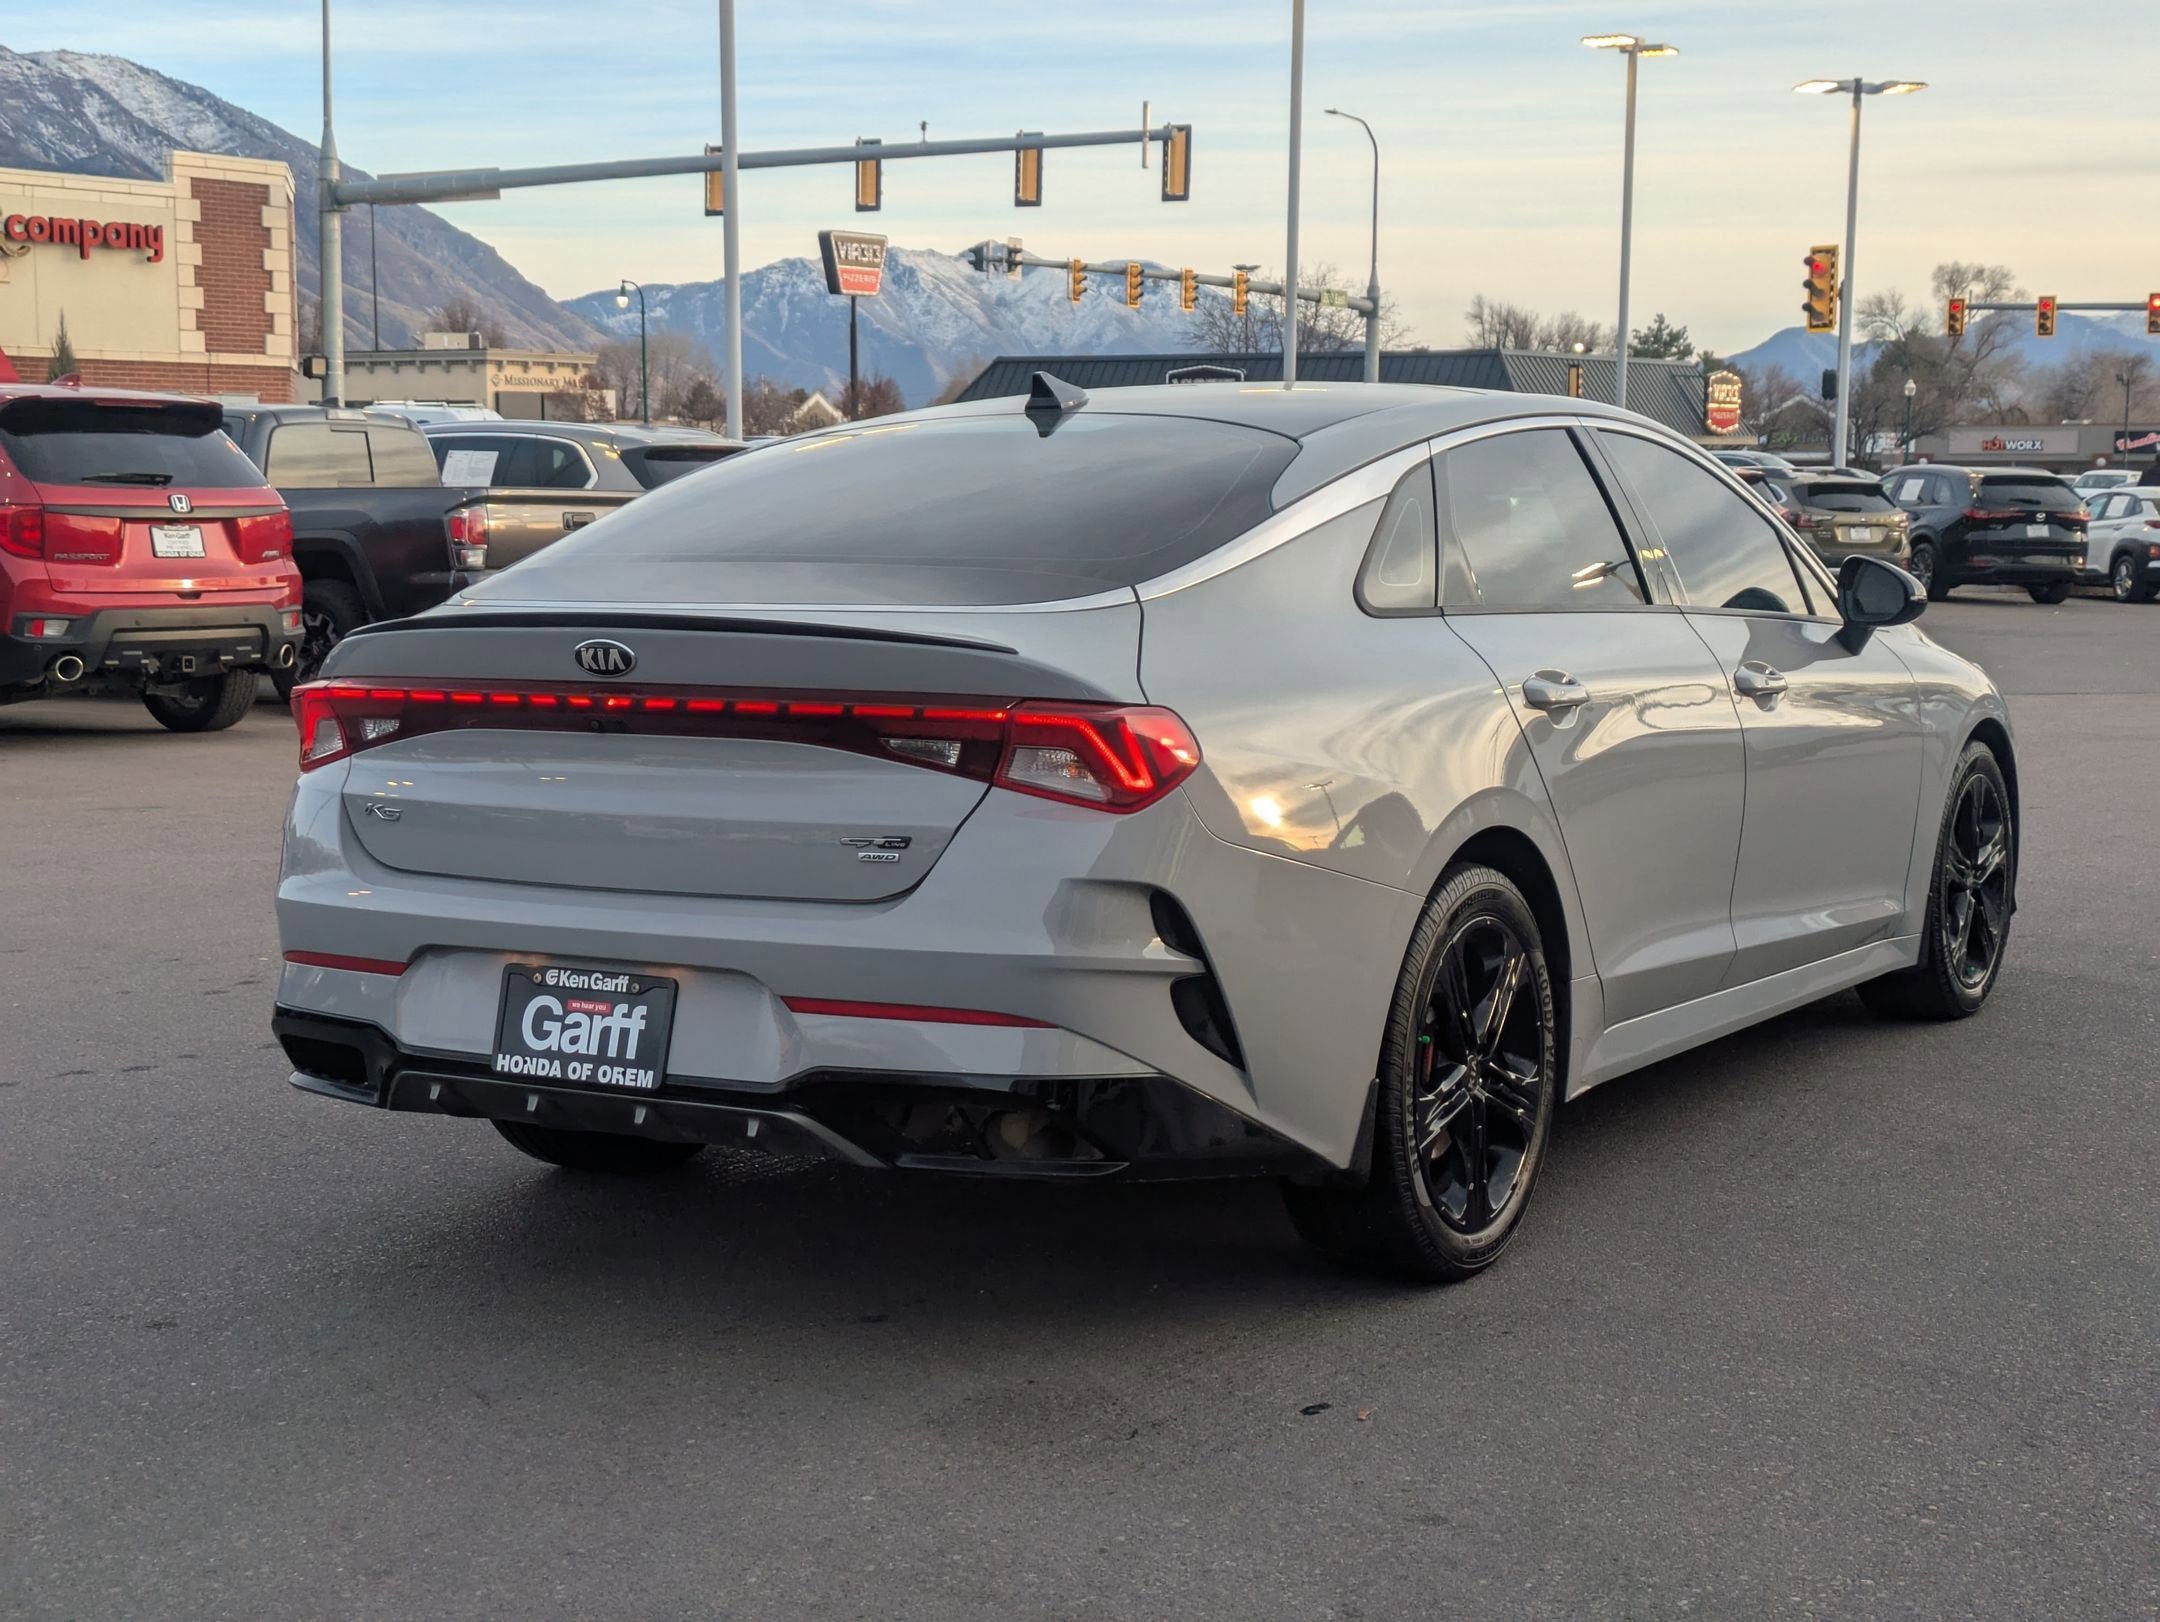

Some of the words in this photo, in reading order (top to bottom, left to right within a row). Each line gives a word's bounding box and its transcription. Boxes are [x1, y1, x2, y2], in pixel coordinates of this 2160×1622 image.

[5, 214, 164, 262] company
[1982, 437, 2042, 451] HOTWORX
[581, 647, 626, 670] KIA
[366, 803, 402, 821] K5
[559, 969, 589, 989] Ken
[590, 973, 629, 993] Garff
[581, 1001, 594, 1010] hear
[595, 1003, 607, 1012] you
[522, 995, 648, 1060] Garff
[496, 1053, 562, 1078] HONDA
[567, 1061, 593, 1080] OF
[597, 1064, 654, 1088] OREM
